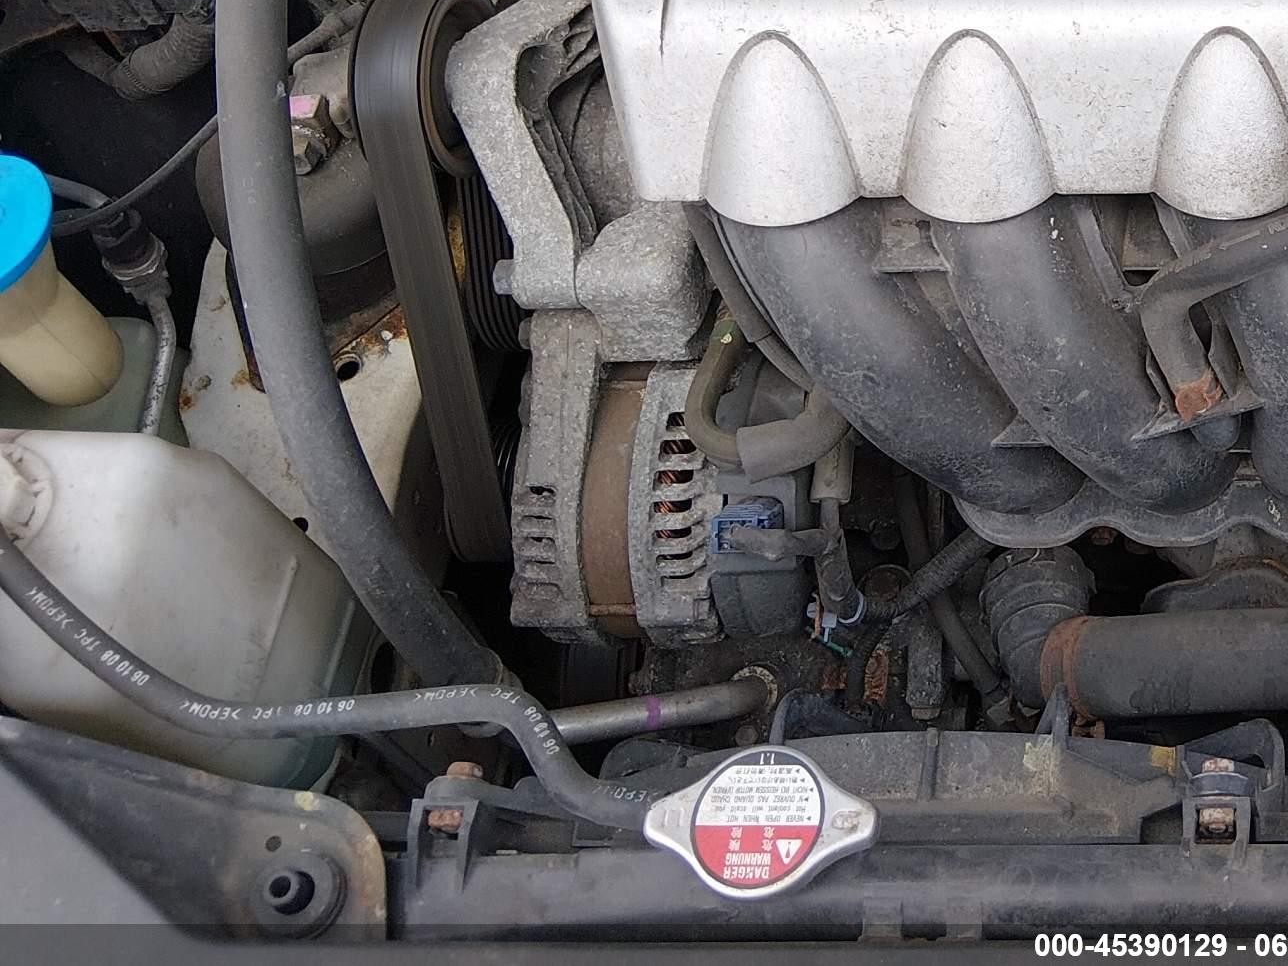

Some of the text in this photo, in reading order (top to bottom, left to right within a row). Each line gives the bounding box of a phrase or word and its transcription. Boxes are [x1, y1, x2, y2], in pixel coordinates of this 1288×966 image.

[100, 650, 120, 665] 08
[118, 660, 133, 679] 10
[133, 671, 150, 686] 06
[295, 704, 313, 716] 08
[318, 701, 333, 714] 10
[338, 699, 355, 711] 06
[524, 706, 542, 721] 08
[533, 722, 550, 738] 10
[543, 739, 560, 755] 06
[760, 753, 776, 764] 1.1
[725, 852, 771, 865] WARNUNG
[723, 866, 770, 879] DANGER
